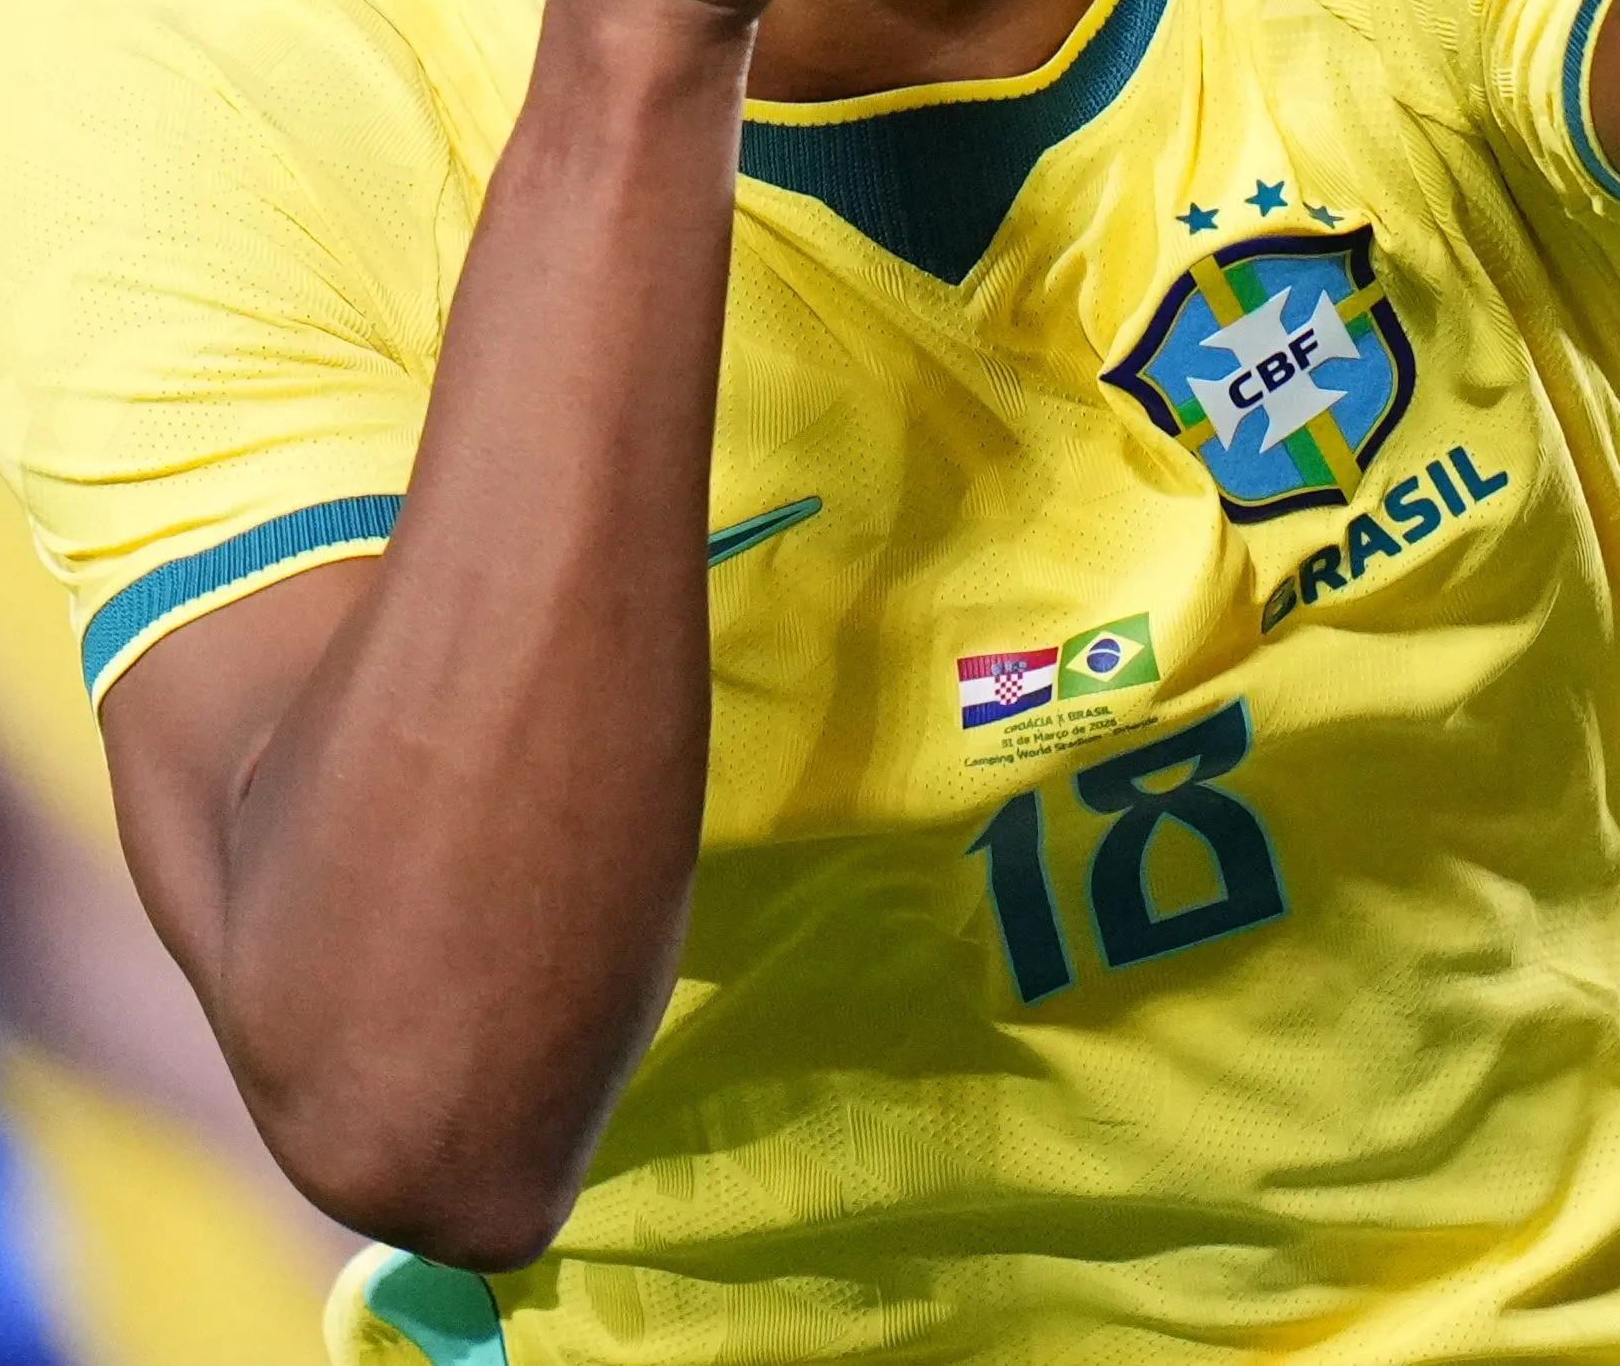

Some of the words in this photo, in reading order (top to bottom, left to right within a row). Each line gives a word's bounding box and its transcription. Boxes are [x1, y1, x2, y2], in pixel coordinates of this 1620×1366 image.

[1227, 328, 1320, 409] CBF
[1261, 445, 1509, 635] BRASIL
[1016, 735, 1031, 746] de
[1033, 729, 1069, 743] Março
[1071, 725, 1086, 737] de
[1068, 706, 1113, 721] BRASIL
[964, 754, 1015, 767] Camping
[1016, 746, 1052, 760] World
[963, 696, 1289, 1008] 18
